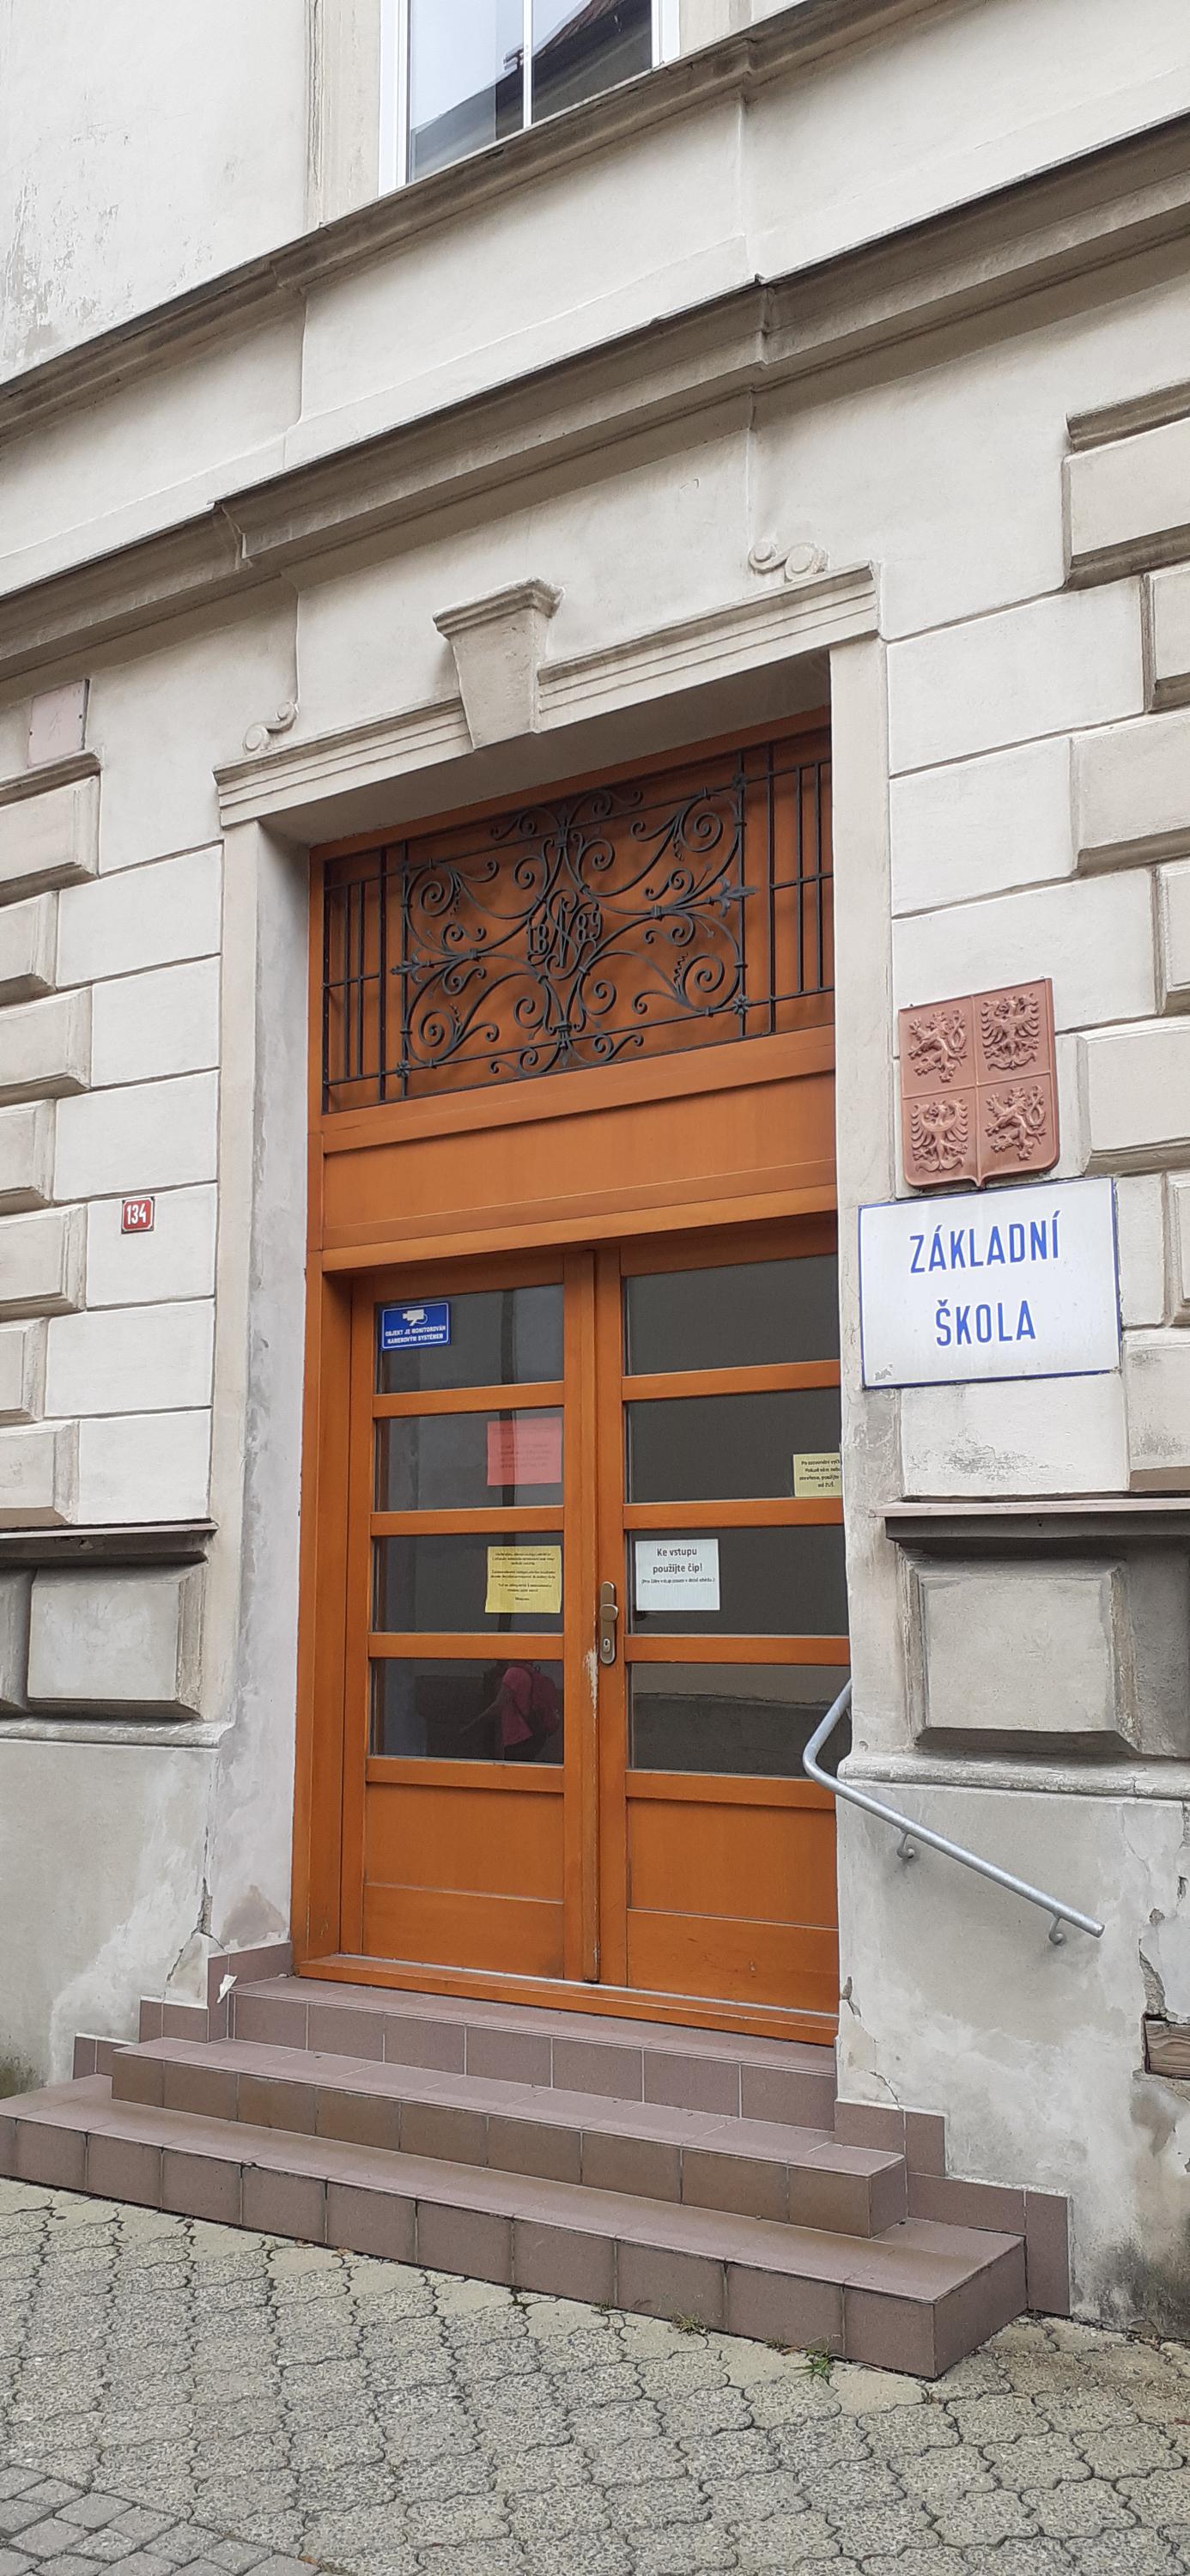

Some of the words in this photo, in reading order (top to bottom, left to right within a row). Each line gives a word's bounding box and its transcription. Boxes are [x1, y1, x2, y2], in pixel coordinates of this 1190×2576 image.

[126, 1203, 146, 1224] 134
[908, 1210, 1061, 1273] ZÁKLADNÍ
[935, 1298, 1036, 1346] ŠKOLA
[669, 1548, 697, 1557] vstupu
[653, 1564, 686, 1575] použijte
[688, 1563, 703, 1573] čip!
